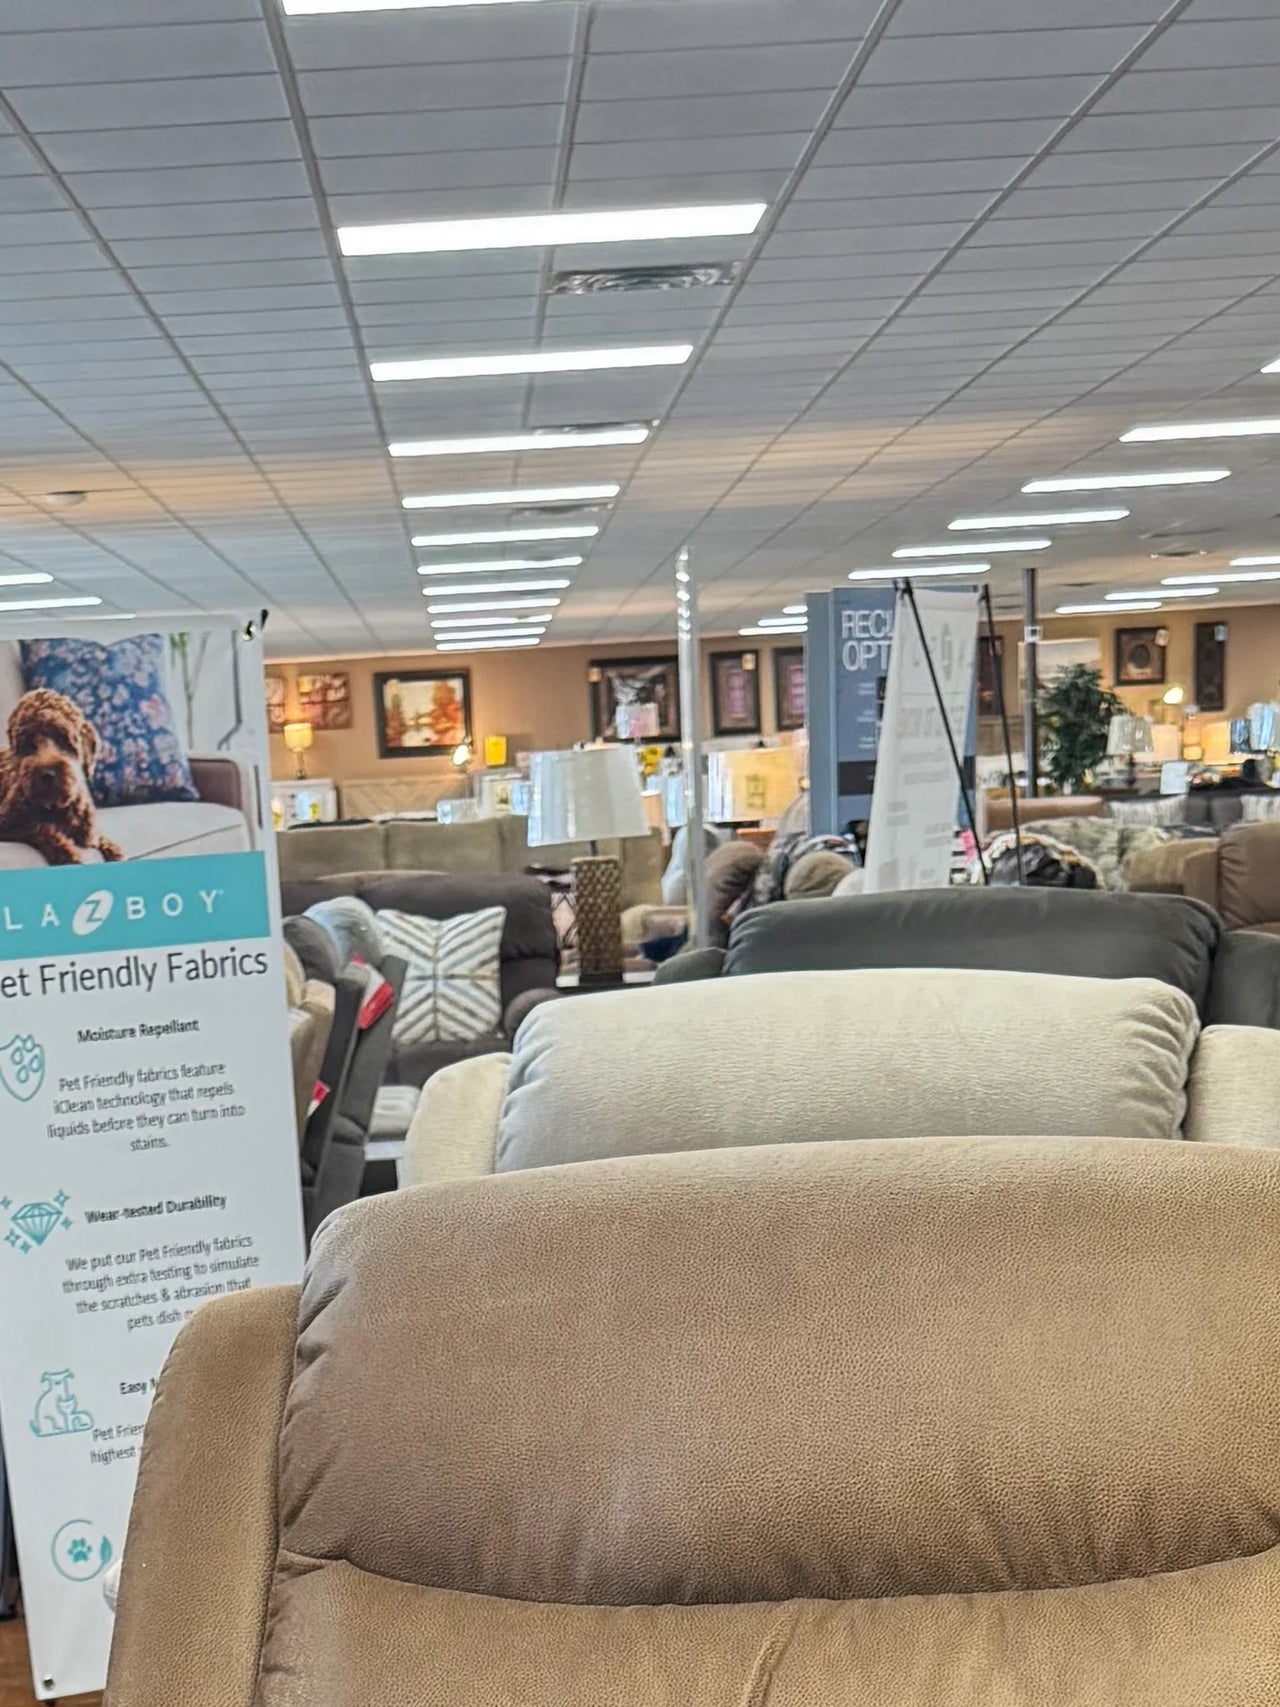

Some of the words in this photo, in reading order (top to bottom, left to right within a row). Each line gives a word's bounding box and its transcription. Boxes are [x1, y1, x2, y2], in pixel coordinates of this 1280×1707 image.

[39, 955, 157, 995] Friendly
[167, 946, 268, 983] Fabrics
[77, 1027, 136, 1044] Moisture
[58, 1077, 80, 1091] Pet
[83, 1070, 135, 1088] Friendly
[137, 1066, 179, 1082] fabrics
[180, 1063, 226, 1078] feature
[53, 1099, 94, 1114] iClean
[96, 1091, 168, 1111] technology
[169, 1086, 194, 1100] that
[196, 1081, 236, 1098] repels
[47, 1122, 90, 1140] liquids
[92, 1116, 134, 1133] before
[136, 1113, 165, 1129] they
[167, 1112, 190, 1125] can
[191, 1107, 219, 1121] turn
[220, 1104, 246, 1119] into
[84, 1201, 164, 1224] Wear-tested
[165, 1194, 227, 1214] Durability
[65, 1257, 89, 1271] We
[90, 1254, 113, 1271] put
[114, 1252, 136, 1265] our
[138, 1247, 160, 1262] Pet
[162, 1240, 212, 1257] Friendly
[212, 1235, 254, 1250] fabrics
[62, 1275, 114, 1294] through
[115, 1271, 148, 1287] extra
[150, 1264, 192, 1281] testing
[193, 1263, 208, 1275] to
[209, 1255, 260, 1272] simulate
[75, 1299, 99, 1314] the
[101, 1291, 158, 1310] scratches
[160, 1288, 170, 1302] &
[173, 1283, 225, 1300] abrasion
[227, 1278, 251, 1292] that
[127, 1315, 155, 1331] pets
[156, 1309, 182, 1325] dish
[119, 1382, 147, 1395] Easy
[92, 1427, 114, 1441] Pet
[115, 1424, 145, 1438] Frie
[90, 1446, 136, 1466] highest
